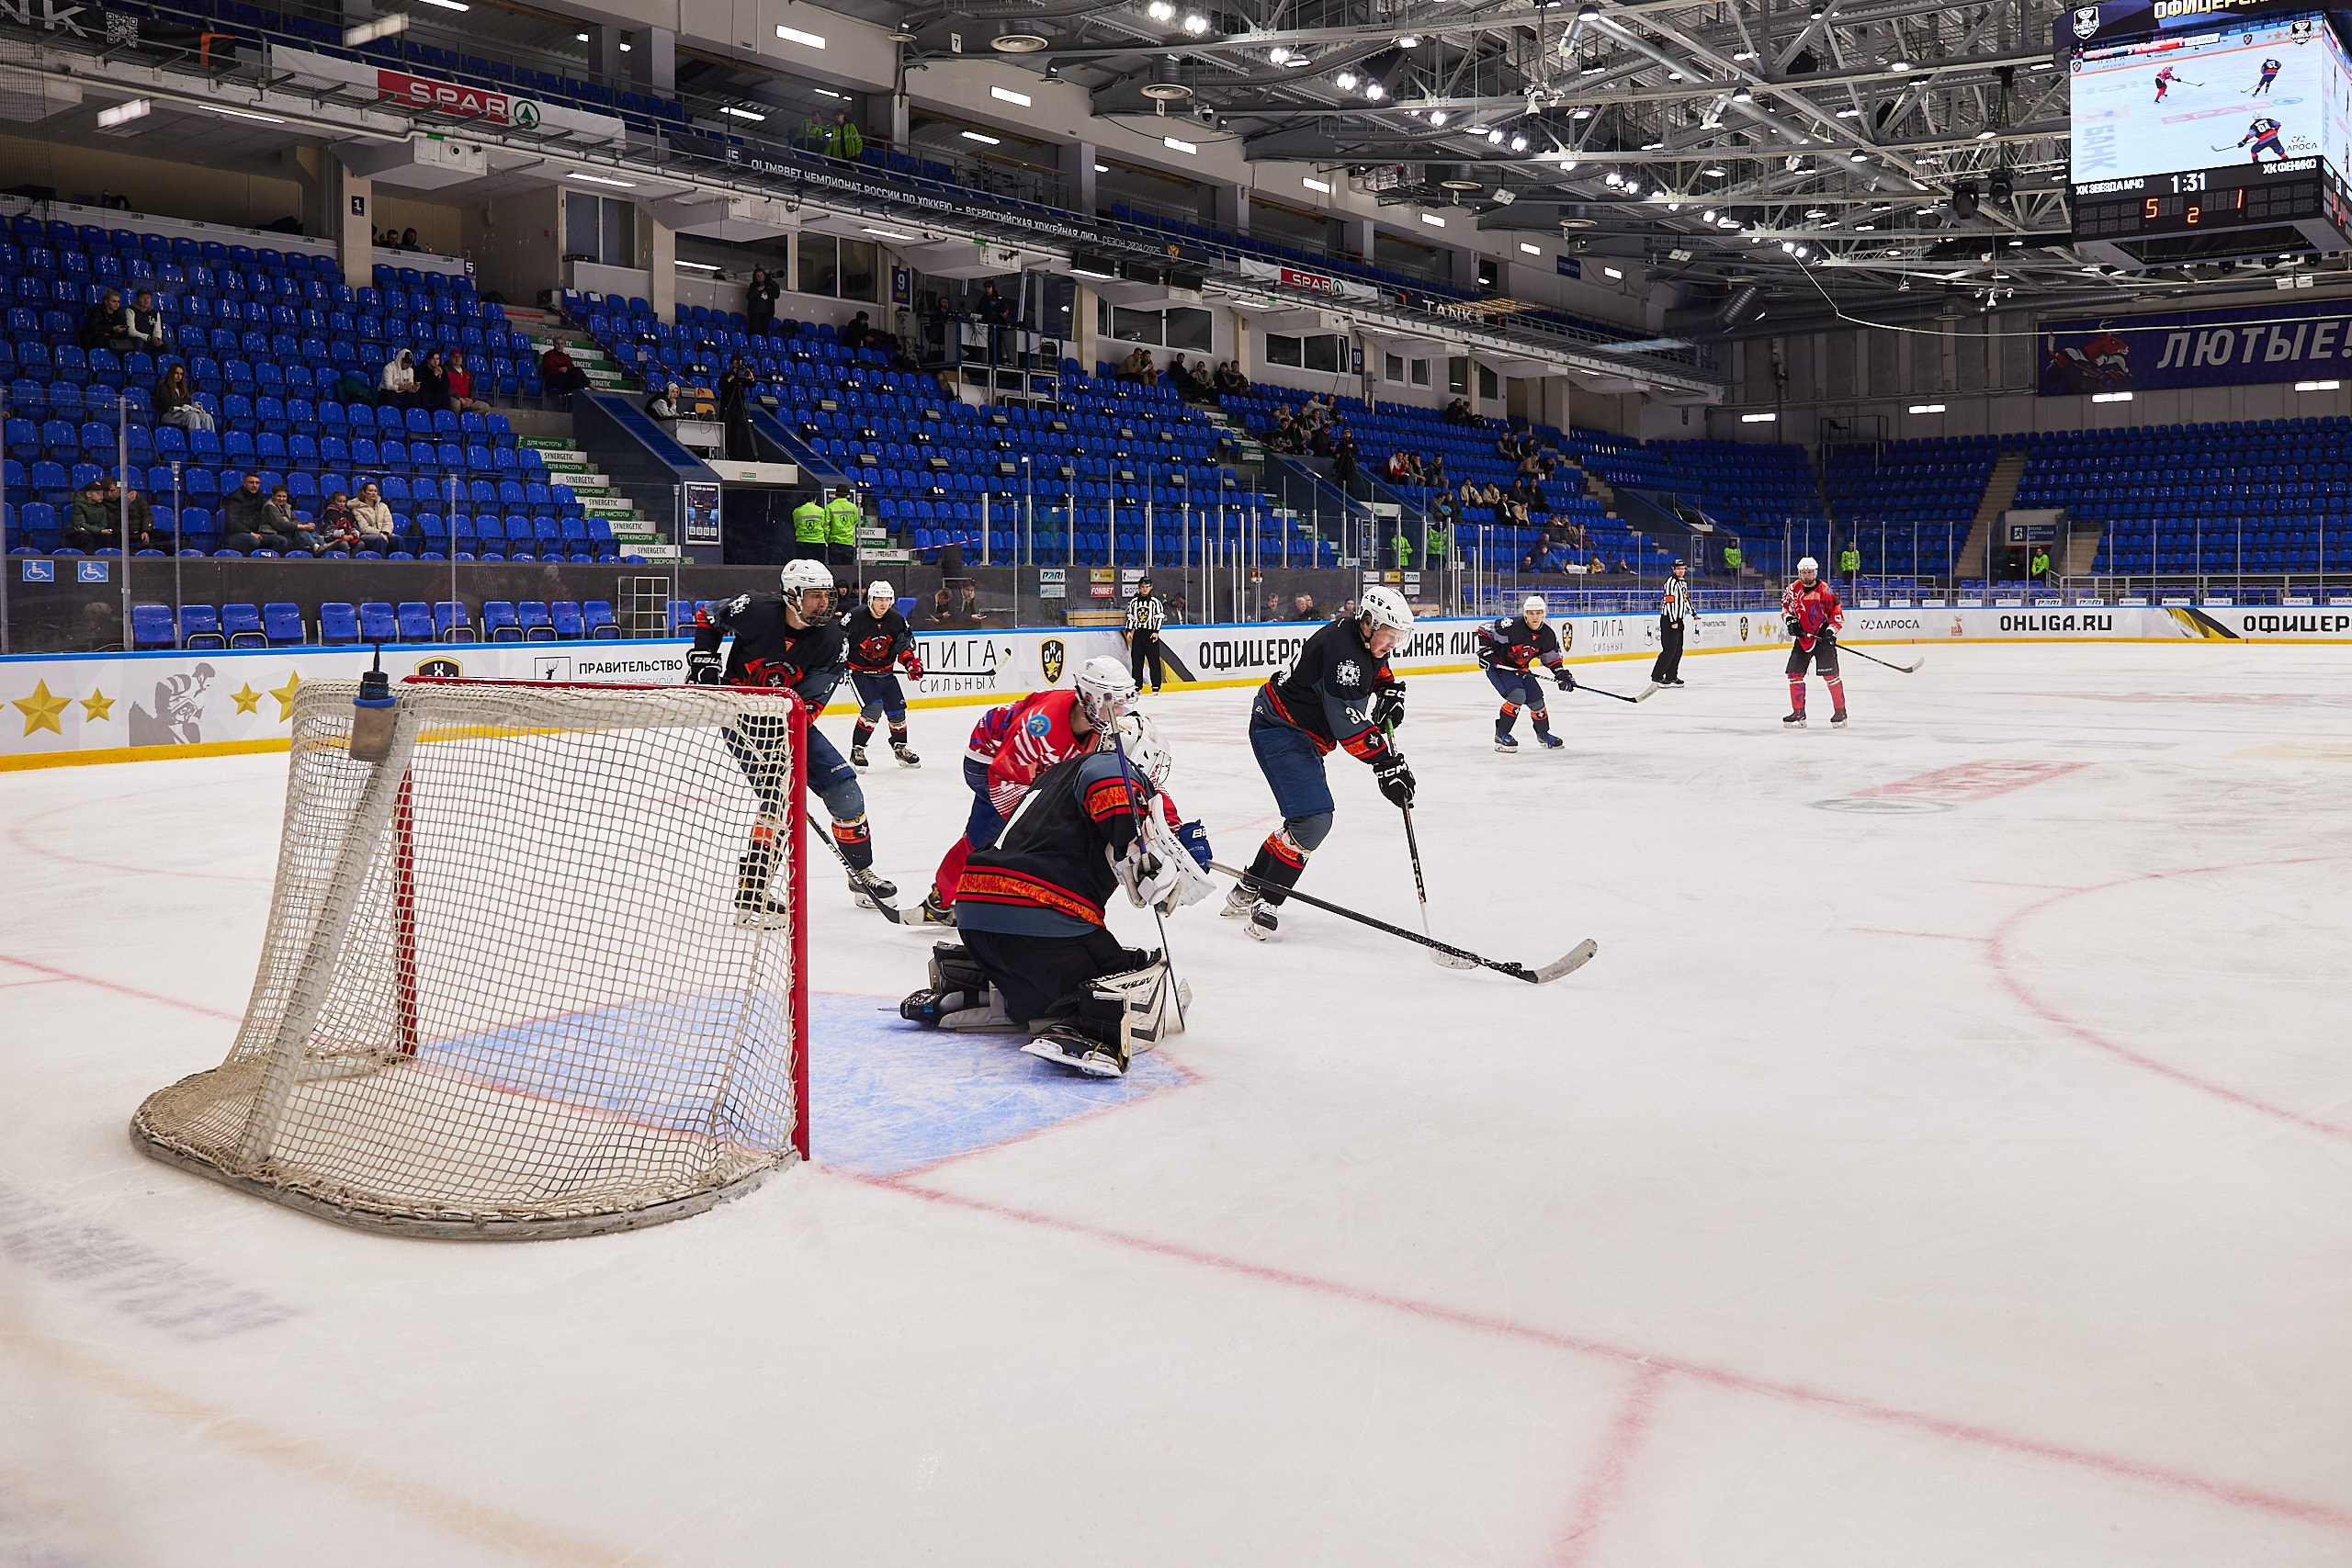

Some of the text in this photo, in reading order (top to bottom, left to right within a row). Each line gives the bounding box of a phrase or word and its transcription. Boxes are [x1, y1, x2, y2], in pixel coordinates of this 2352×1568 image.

[954, 39, 958, 49] 7
[410, 82, 506, 117] SPAR
[1159, 103, 1164, 113] 6
[2171, 172, 2206, 194] 1:31
[355, 199, 362, 211] 1
[2145, 197, 2159, 220] 5
[2188, 207, 2199, 224] 2
[466, 261, 475, 273] 5
[898, 273, 906, 290] 9
[1293, 274, 1330, 292] SPAR
[2156, 321, 2352, 368] ЛЮТЫЕ!
[1353, 350, 1362, 365] 10
[544, 453, 573, 461] SYNERGETIC
[566, 476, 595, 485] SYNERGETIC
[589, 499, 617, 507] SYNERGETIC
[613, 523, 642, 531] SYNERGETIC
[637, 547, 666, 555] SYNERGETIC
[1042, 571, 1064, 581] PARI
[1091, 587, 1114, 595] FONBET
[1591, 619, 1624, 637] ЛИГА
[2000, 615, 2113, 632] OHLIGA.RU
[1199, 637, 1306, 671] ОФИЦЕРС
[579, 660, 684, 675] ПРАВИТЕЛЬСТВО
[919, 675, 996, 694] СИЛЬНЫХ
[1376, 762, 1408, 779] CCM
